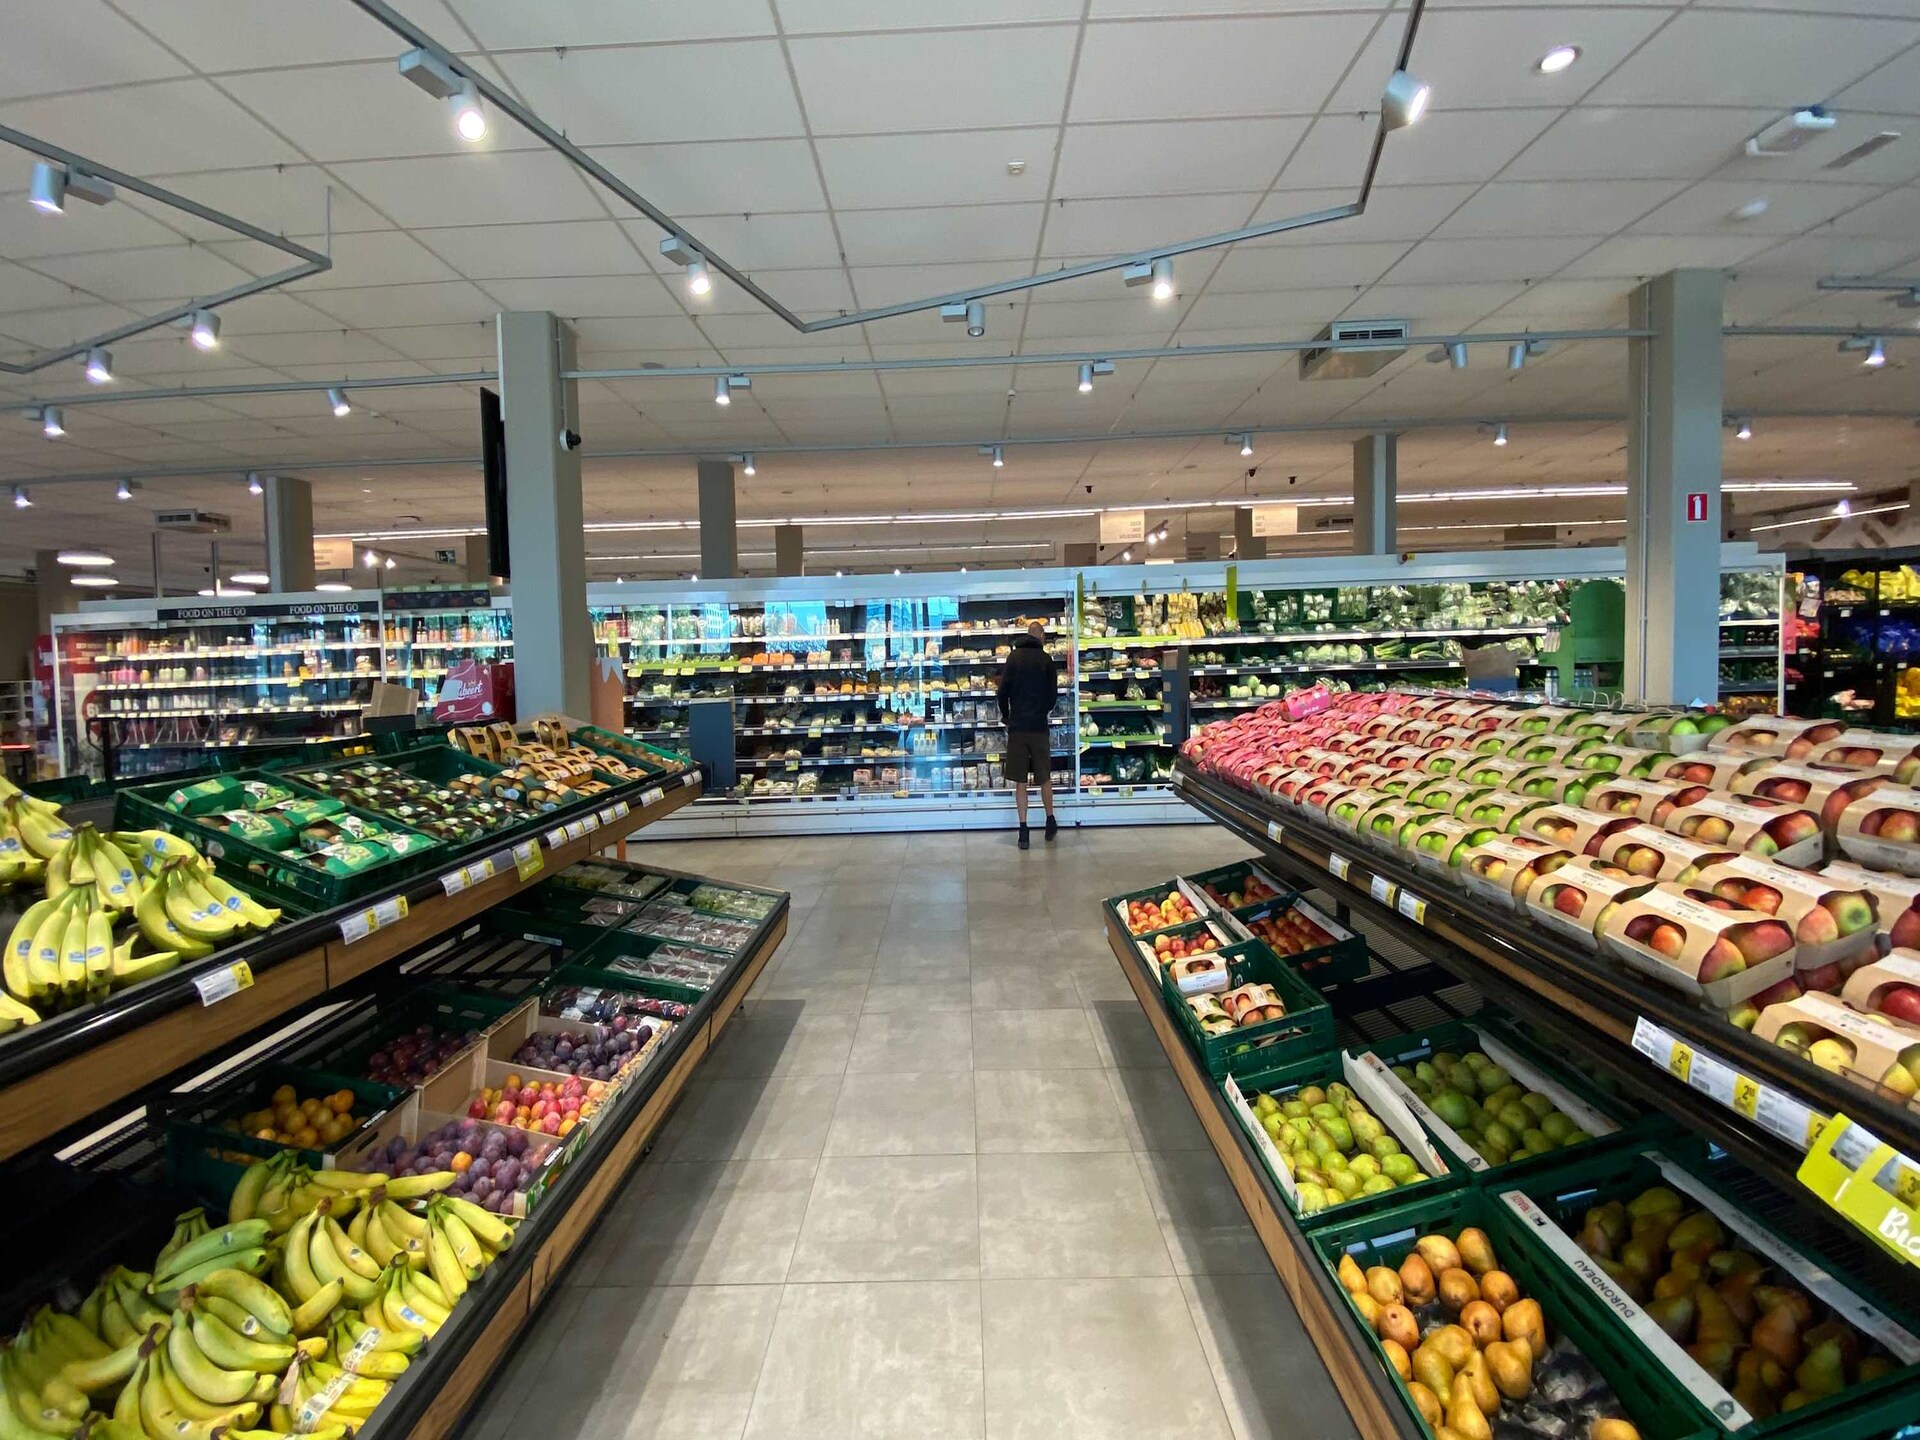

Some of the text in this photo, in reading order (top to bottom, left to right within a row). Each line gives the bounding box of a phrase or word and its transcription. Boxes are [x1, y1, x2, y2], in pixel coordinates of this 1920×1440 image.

[178, 607, 247, 618] FOOD ON THE GO
[289, 603, 359, 615] FOOD ON THE GO
[1574, 1259, 1636, 1319] DURONDEAU
